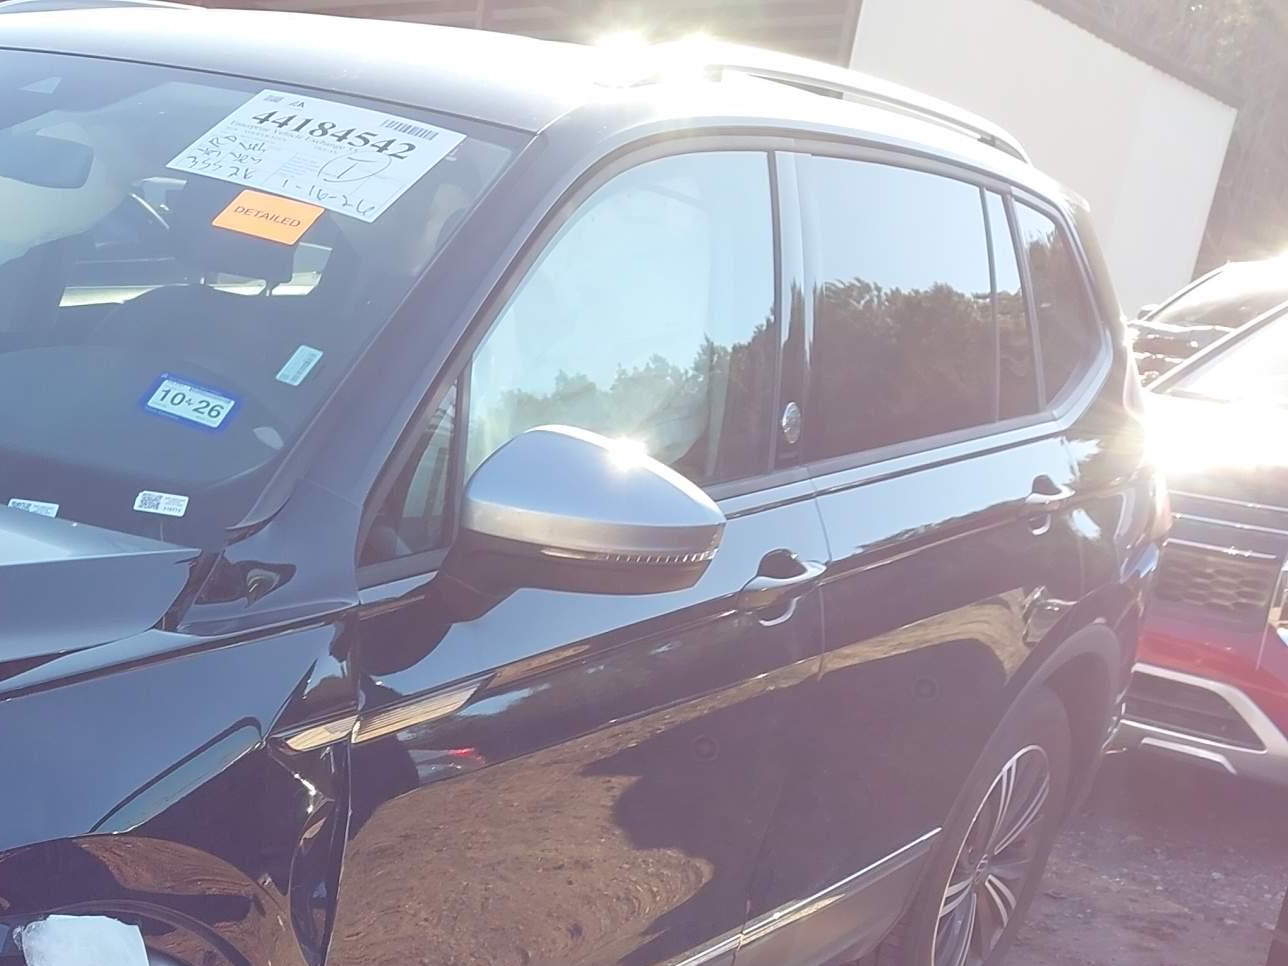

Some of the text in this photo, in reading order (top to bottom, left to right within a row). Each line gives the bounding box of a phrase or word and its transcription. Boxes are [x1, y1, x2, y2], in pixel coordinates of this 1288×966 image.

[252, 110, 418, 160] 44184542
[233, 205, 302, 228] DETAILED
[159, 388, 187, 407] 10
[192, 399, 225, 419] 26
